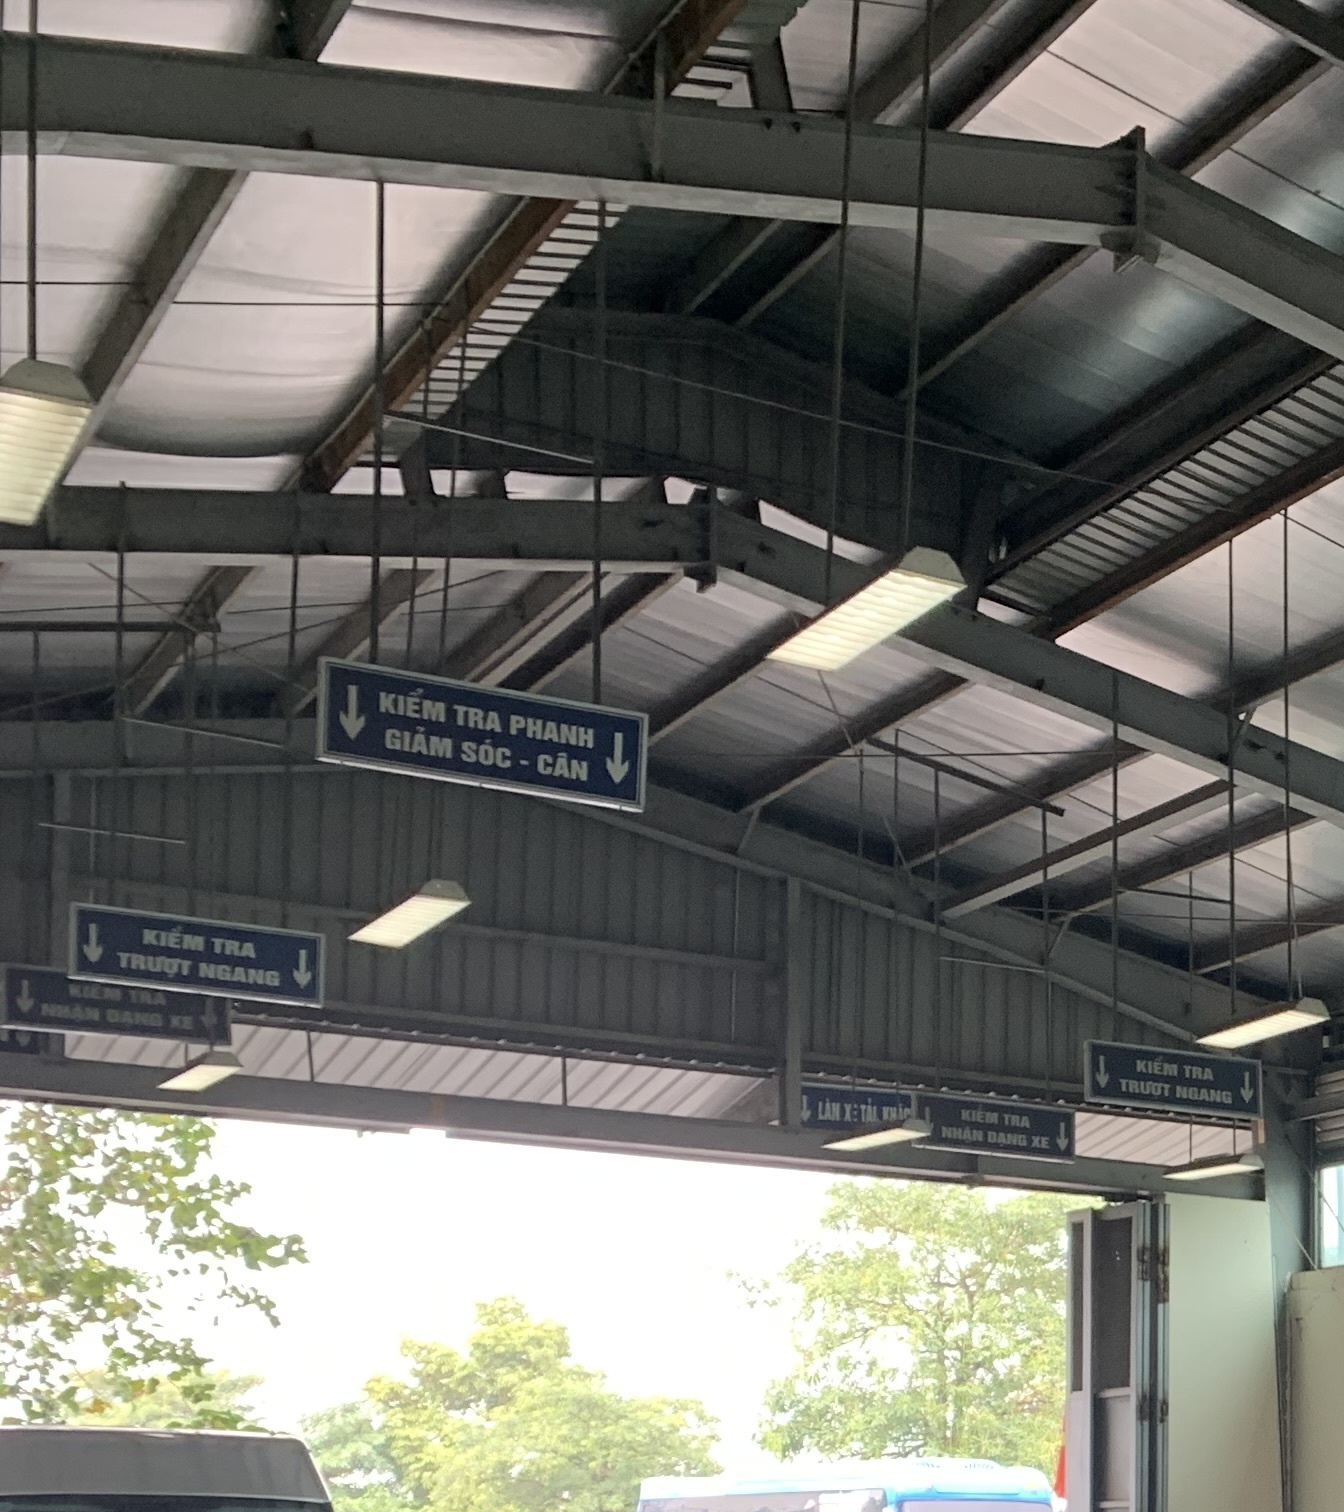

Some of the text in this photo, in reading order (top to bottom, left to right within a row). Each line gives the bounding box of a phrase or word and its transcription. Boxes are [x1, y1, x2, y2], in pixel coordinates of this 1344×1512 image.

[379, 688, 595, 749] KIỂM TRA PHANH
[384, 726, 453, 759] GIẢM
[460, 739, 512, 768] SÓC
[537, 752, 588, 782] CÂN
[142, 925, 257, 959] KIỂM TRA
[116, 952, 281, 987] TRƯỢT NGANG
[1136, 1055, 1214, 1081] KIỂM TRA
[1175, 1085, 1232, 1104] NGANG
[1003, 1114, 1030, 1129] TRA
[1031, 1135, 1050, 1149] XE
